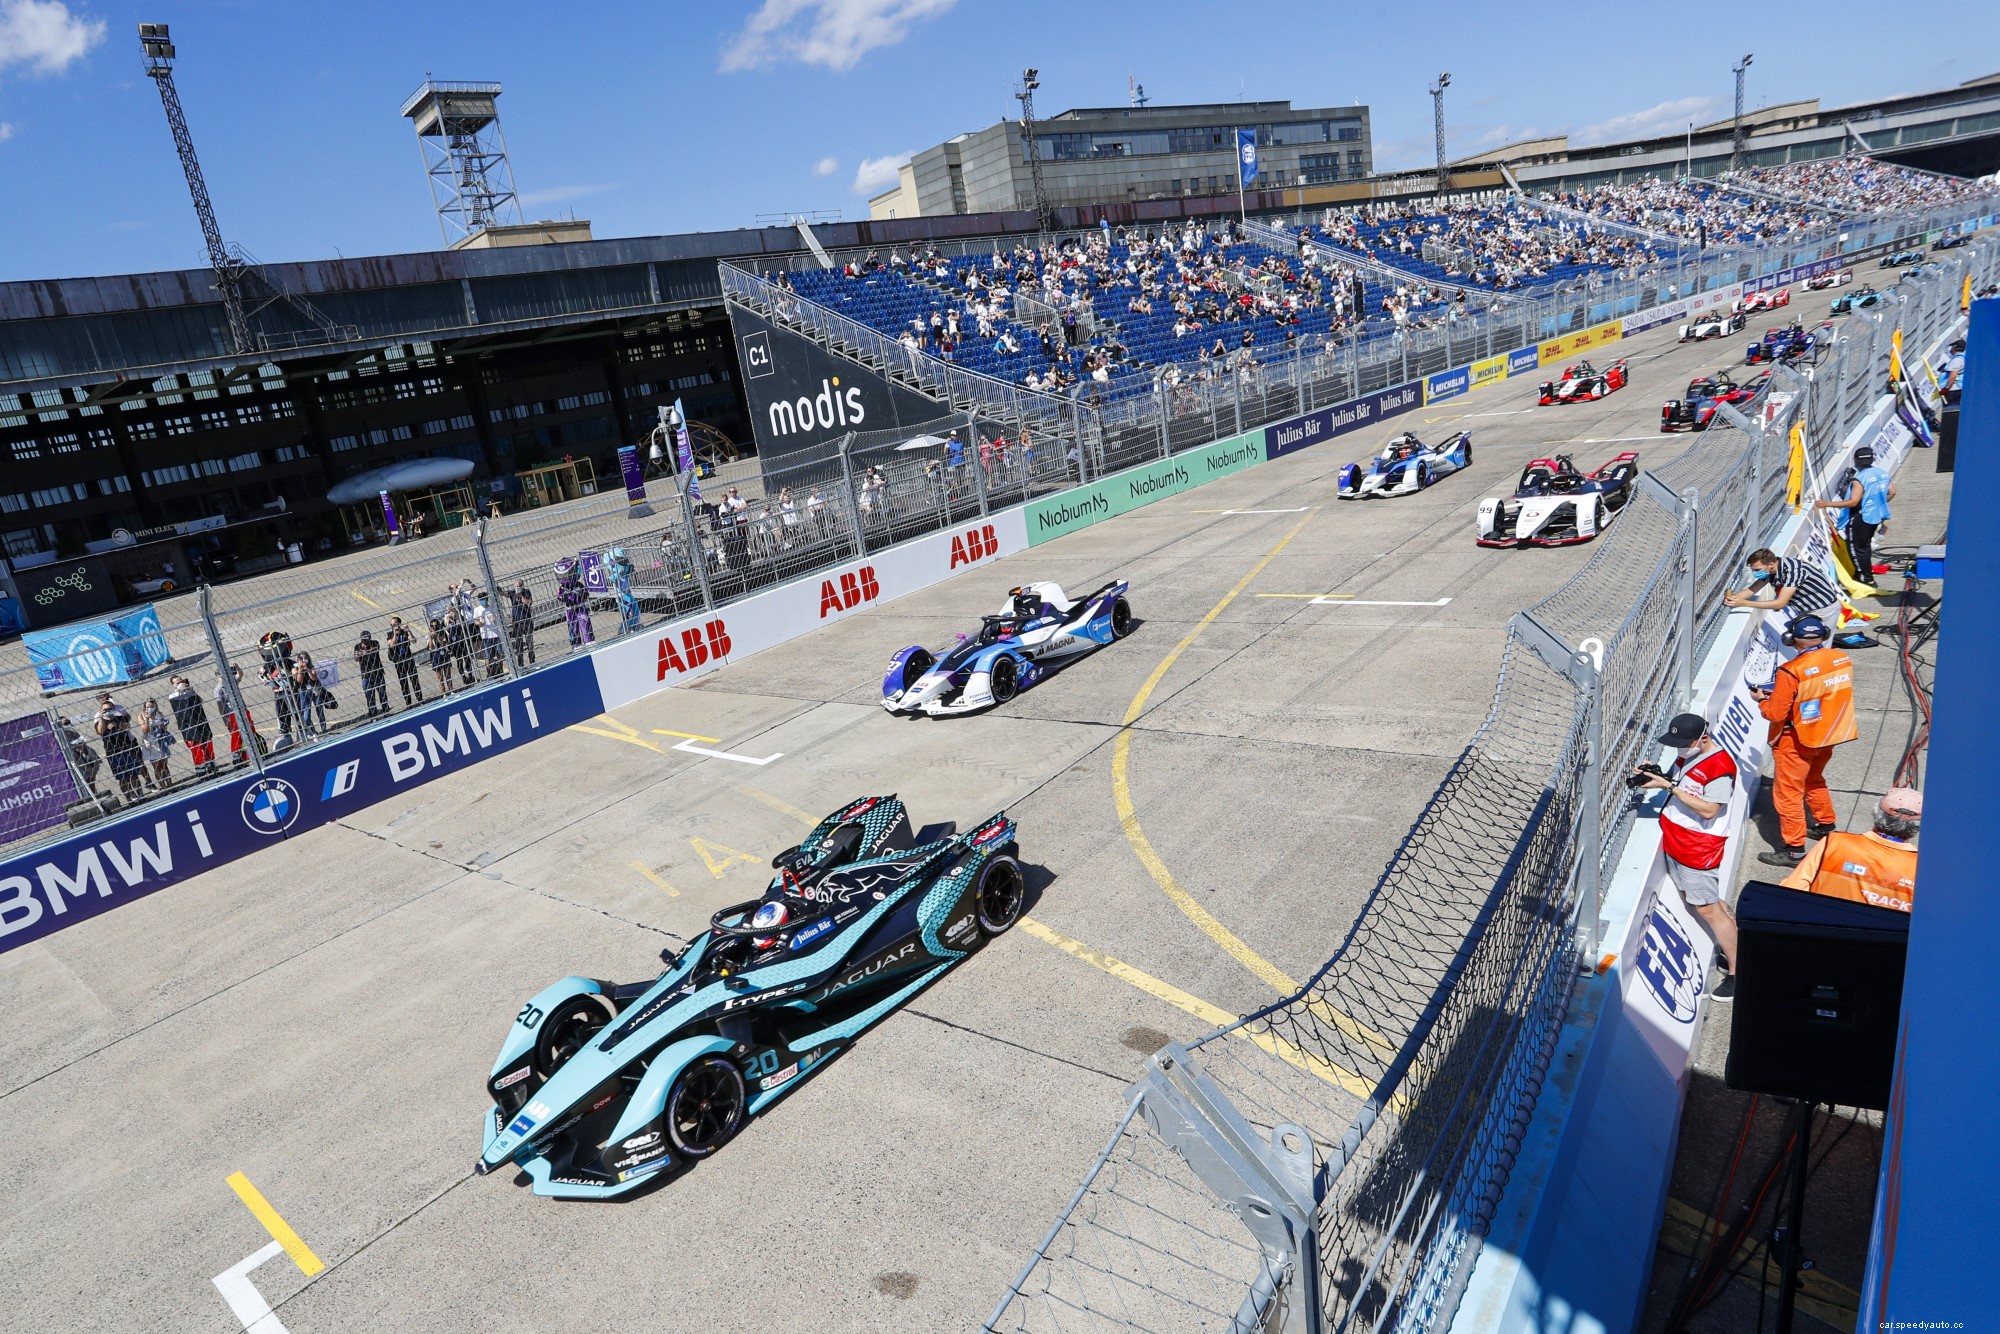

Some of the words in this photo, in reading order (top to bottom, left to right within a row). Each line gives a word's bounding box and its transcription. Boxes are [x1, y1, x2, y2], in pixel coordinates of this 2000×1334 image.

[749, 345, 768, 366] C1
[1513, 353, 1537, 366] MICHELIN
[1435, 375, 1466, 392] MICHELIN
[1477, 364, 1504, 378] MICHELIN
[769, 376, 865, 436] modis
[1380, 395, 1402, 415] Julius
[1402, 389, 1416, 405] Bär
[1331, 410, 1355, 431] Julius
[1356, 403, 1371, 420] Bär
[1276, 427, 1303, 451] Julius
[1304, 420, 1322, 438] Bär
[134, 530, 153, 538] MINI
[951, 524, 998, 570] ABB
[820, 566, 880, 619] ABB
[657, 618, 732, 682] ABB
[1045, 636, 1076, 654] MAGNA
[887, 661, 902, 671] 27
[1824, 673, 1850, 687] TRACK
[382, 695, 512, 783] BMW
[521, 687, 540, 729] i
[871, 812, 905, 854] JAGUAR
[0, 820, 173, 938] BMW
[187, 809, 213, 858] i
[796, 853, 814, 870] EVA
[1862, 889, 1912, 912] TRACK
[797, 927, 818, 945] Julius
[818, 919, 832, 932] Bär
[814, 943, 916, 1003] JAGUAR
[1637, 908, 1692, 1014] FIA
[516, 1003, 544, 1030] 20
[628, 991, 677, 1031] JAGUAR
[503, 1067, 529, 1086] Castrol
[744, 1049, 780, 1080] 20
[770, 1065, 796, 1086] Castrol
[525, 1100, 550, 1120] ABB
[551, 1177, 606, 1186] JAGUAR
